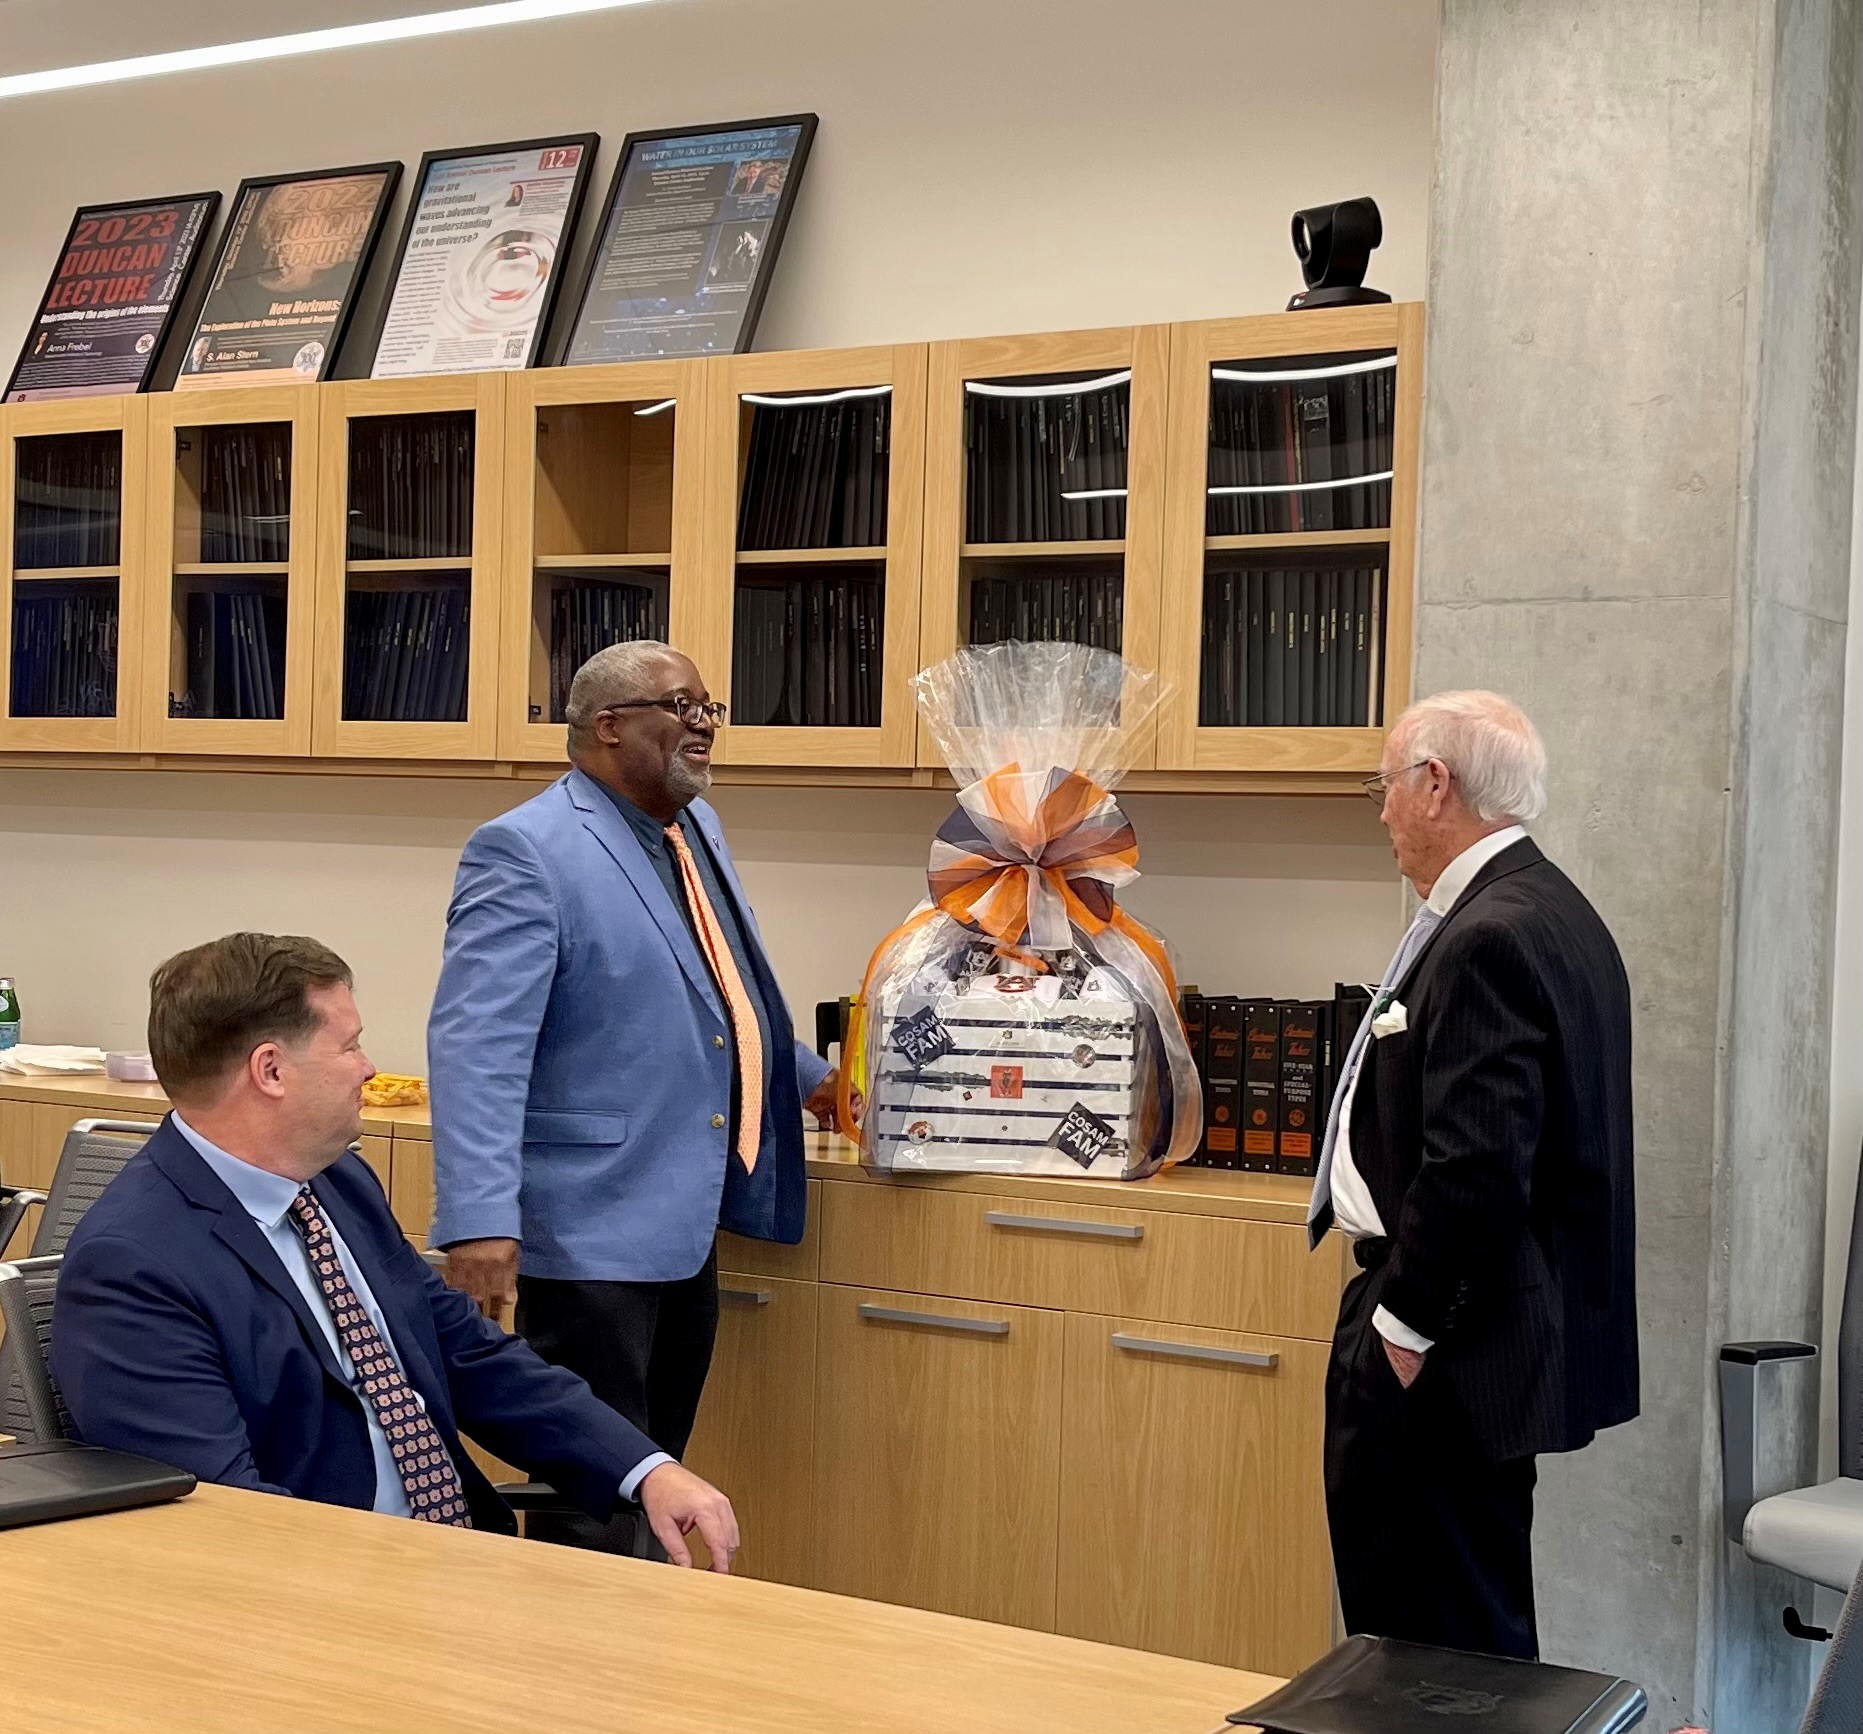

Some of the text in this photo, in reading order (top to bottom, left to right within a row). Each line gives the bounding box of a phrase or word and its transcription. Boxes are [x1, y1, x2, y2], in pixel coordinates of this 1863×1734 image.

[546, 150, 567, 169] 12
[641, 149, 672, 162] WATER
[685, 146, 707, 158] OUR
[707, 142, 739, 155] SOLAR
[738, 138, 778, 152] SYSTEM
[287, 184, 382, 213] 2022
[423, 192, 477, 208] gravitational
[427, 182, 461, 194] How are
[274, 211, 373, 240] DUNCAN
[419, 205, 491, 221] waves advancing
[73, 211, 179, 246] 2023
[415, 218, 493, 235] our understanding
[412, 232, 479, 249] of the universe?
[60, 243, 168, 278] DUNCAN
[264, 240, 362, 269] LECTURE
[47, 273, 155, 309] LECTURE
[269, 302, 294, 316] New
[46, 344, 66, 352] Anna
[206, 350, 259, 362] S. Alan Stern
[898, 1014, 939, 1047] COSAM
[905, 1024, 948, 1061] FAM
[1058, 1122, 1101, 1159] FAM
[1067, 1111, 1109, 1146] COSAM
